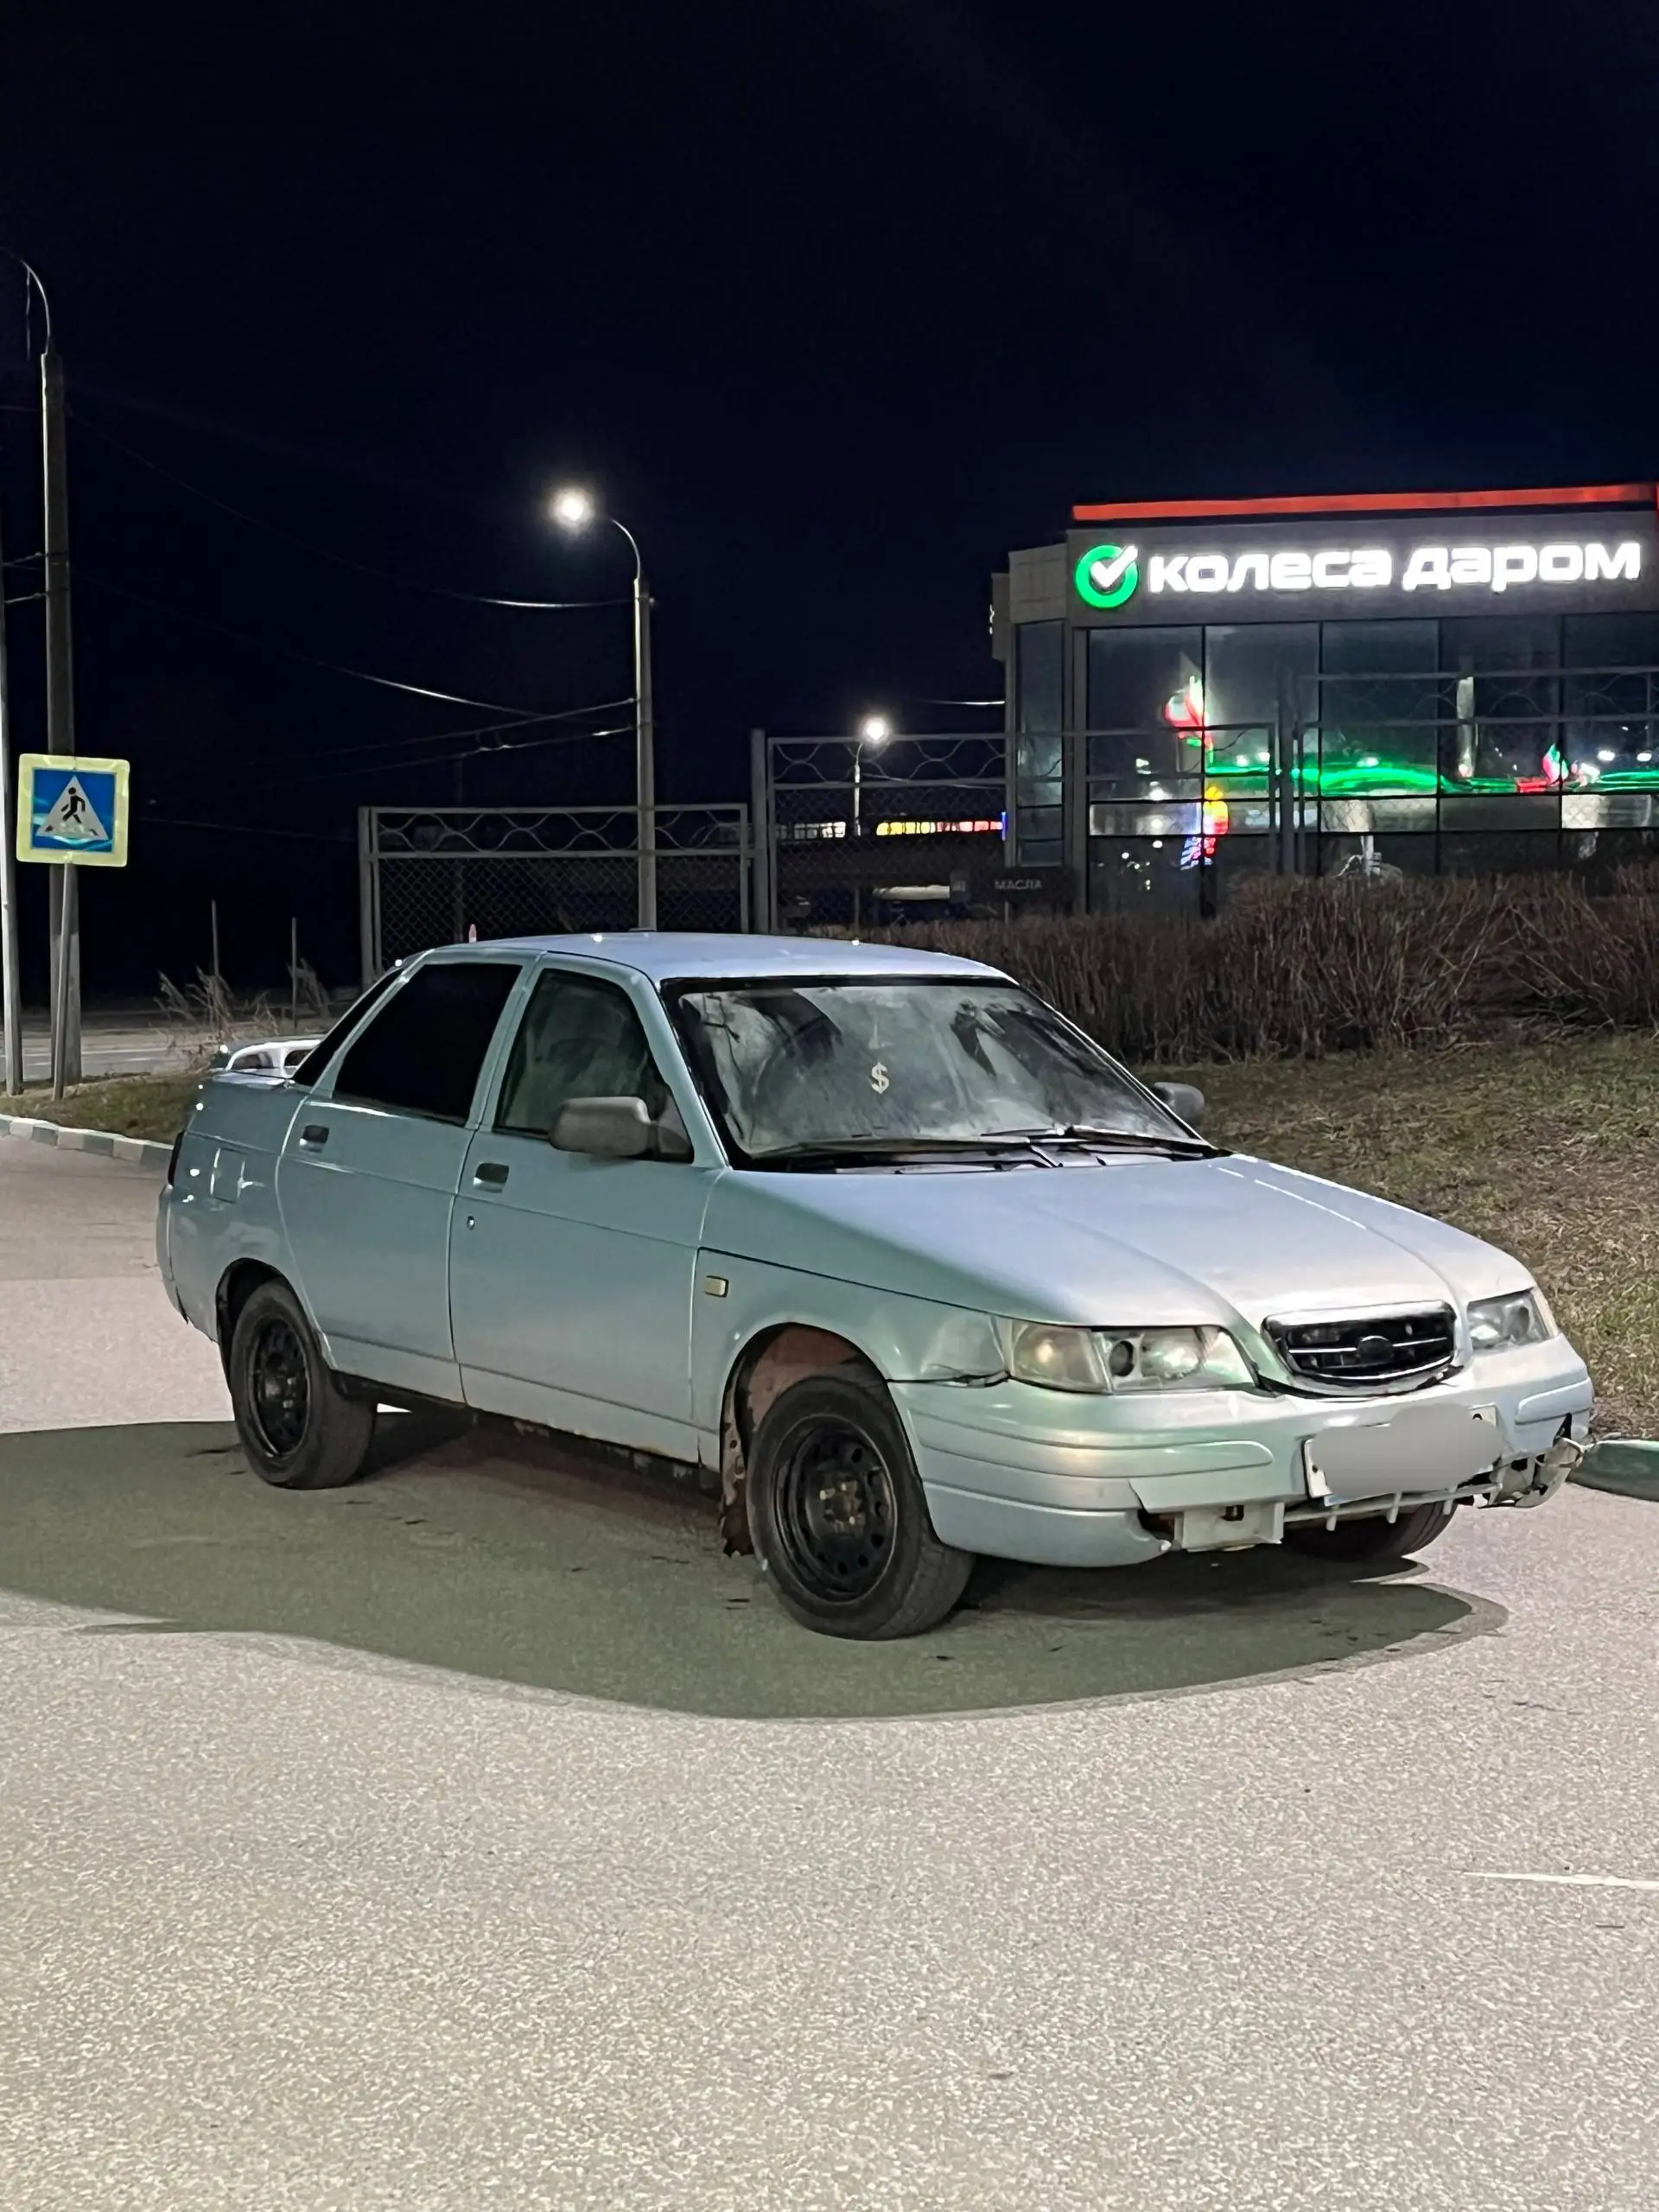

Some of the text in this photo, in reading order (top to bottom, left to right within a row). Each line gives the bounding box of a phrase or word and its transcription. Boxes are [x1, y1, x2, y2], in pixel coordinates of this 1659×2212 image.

[1148, 543, 1641, 594] колеса даром
[994, 879, 1043, 890] МАСЛА
[871, 1062, 890, 1095] $
